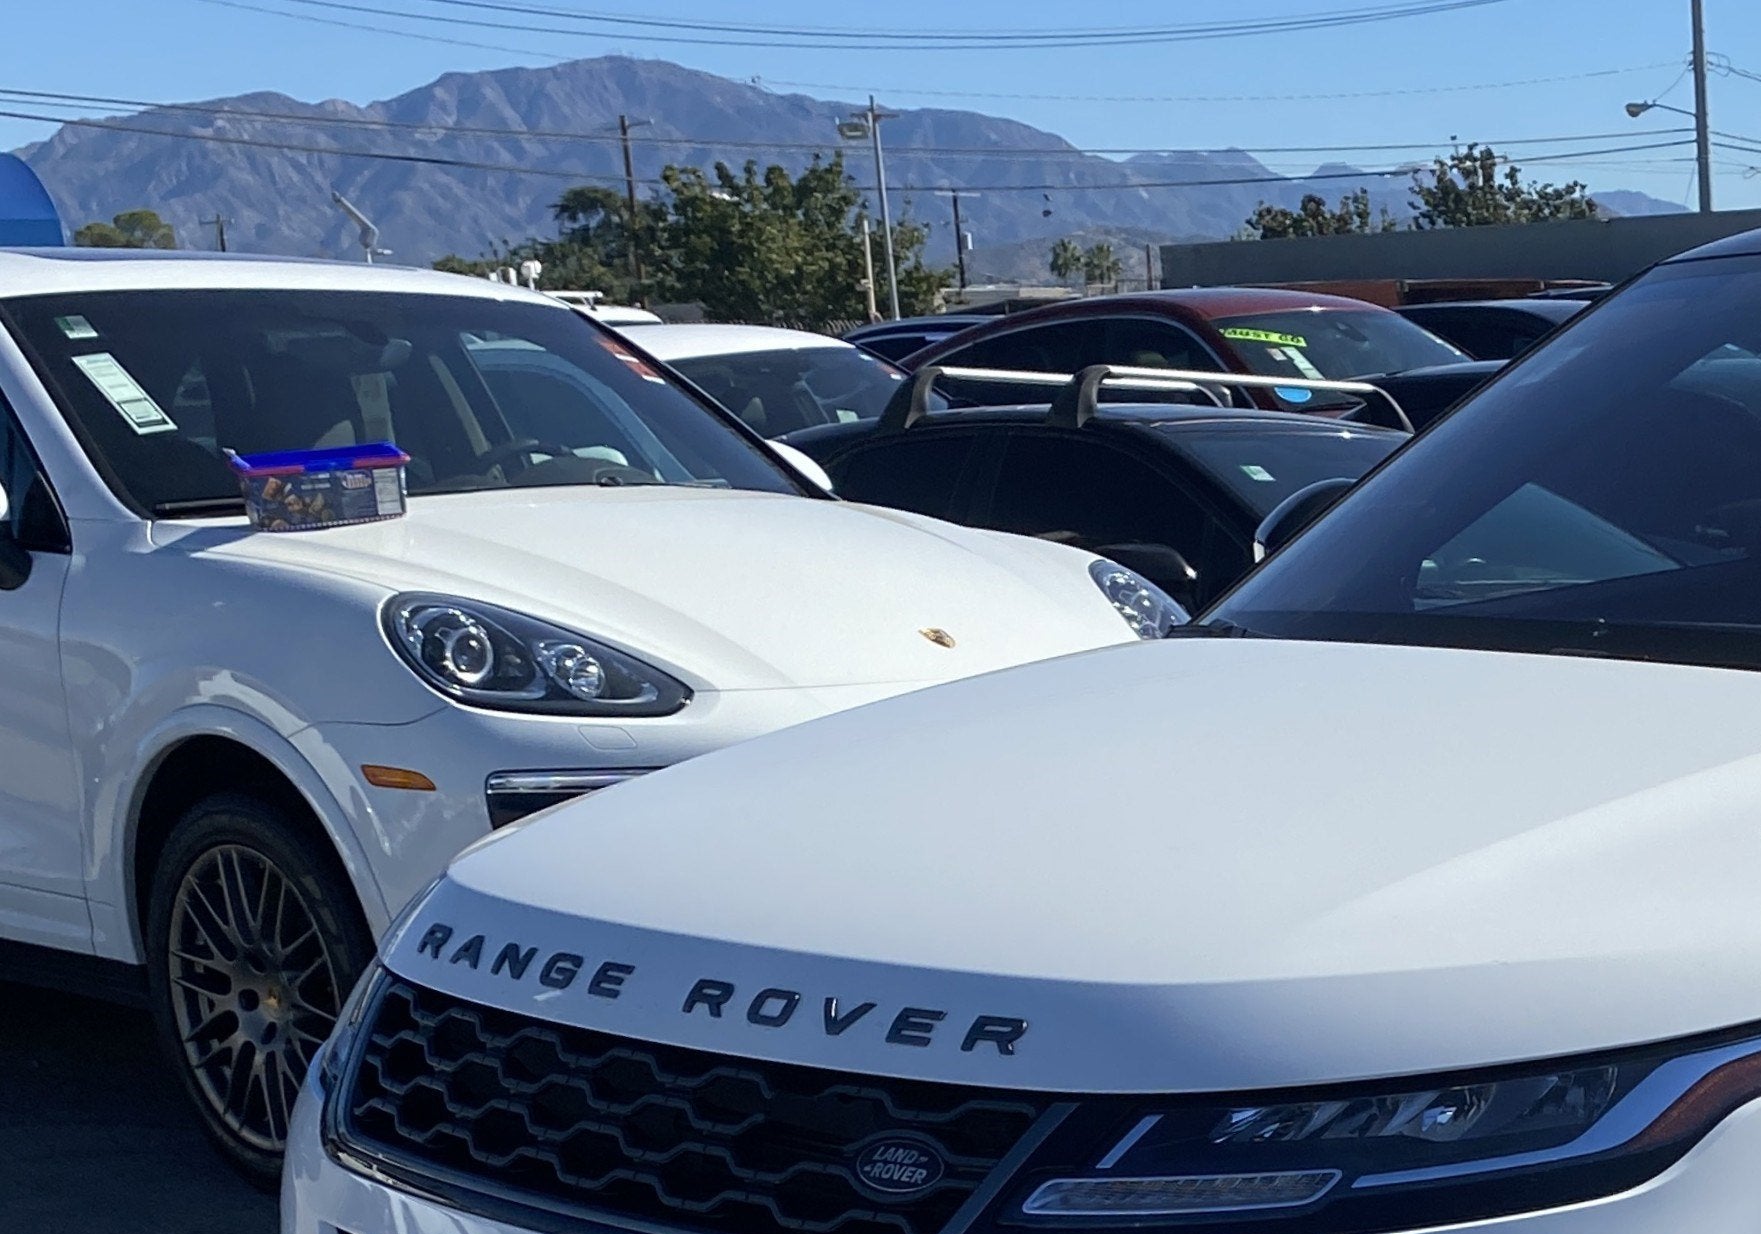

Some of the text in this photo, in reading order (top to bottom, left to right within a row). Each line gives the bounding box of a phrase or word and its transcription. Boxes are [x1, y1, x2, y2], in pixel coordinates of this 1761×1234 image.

[417, 922, 1029, 1056] RANGE ROVER
[872, 1145, 919, 1164] LAND
[869, 1162, 927, 1184] ROVER
